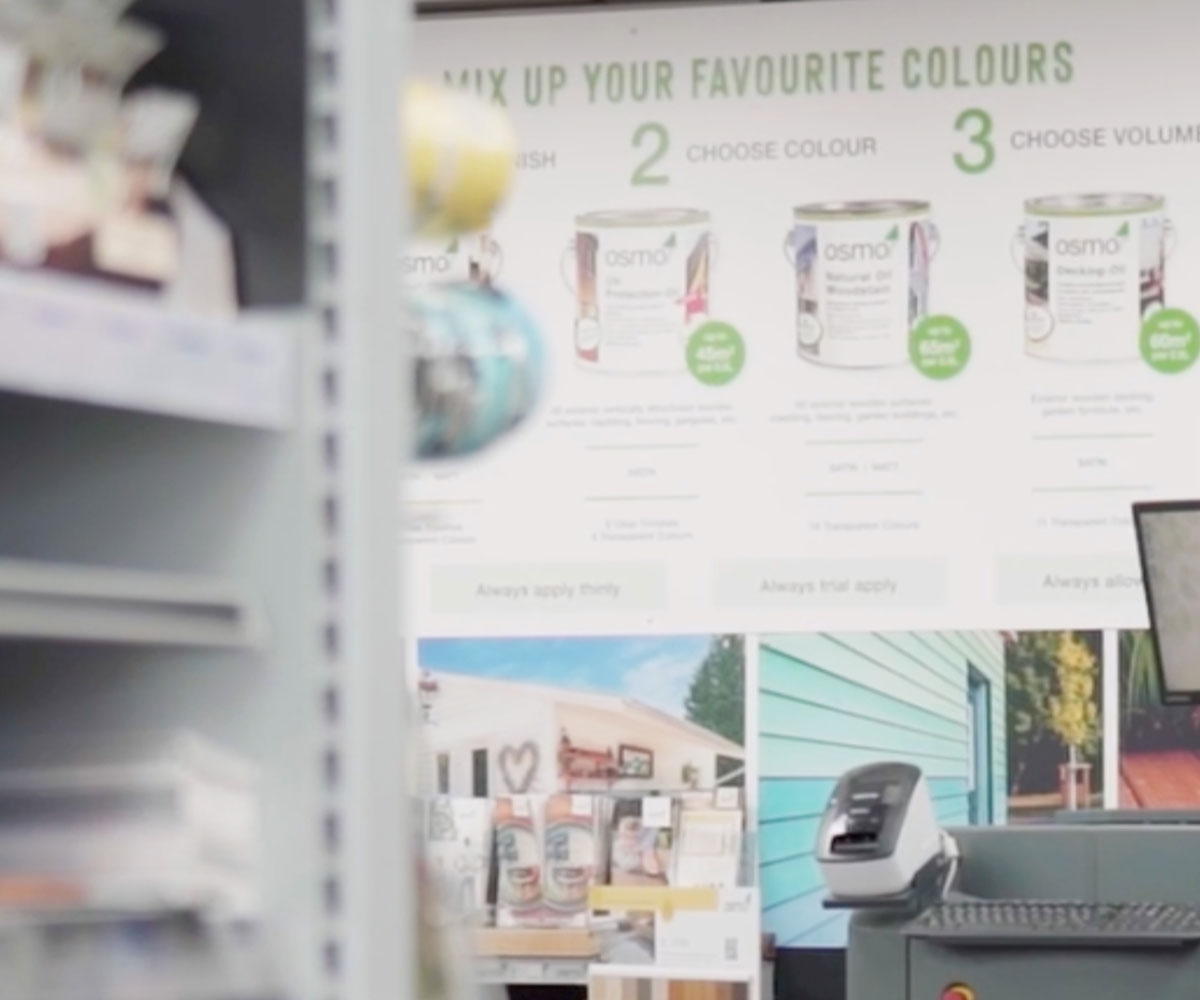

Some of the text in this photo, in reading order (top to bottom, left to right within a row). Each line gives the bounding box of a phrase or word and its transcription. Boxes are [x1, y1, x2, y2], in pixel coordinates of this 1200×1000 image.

[524, 65, 567, 106] UP
[582, 60, 674, 103] YOUR
[690, 49, 886, 99] FAVOURITE
[901, 41, 1075, 90] COLOURS
[686, 136, 878, 164] CHOOSE COLOUR
[951, 107, 996, 174] 3
[1010, 127, 1107, 151] CHOOSE
[629, 121, 671, 187] 2
[823, 242, 890, 261] osmo
[1055, 237, 1120, 257] osmo
[401, 254, 450, 273] smo
[605, 249, 668, 268] osmo
[759, 575, 899, 597] Always trial apply
[1042, 571, 1101, 592] Always
